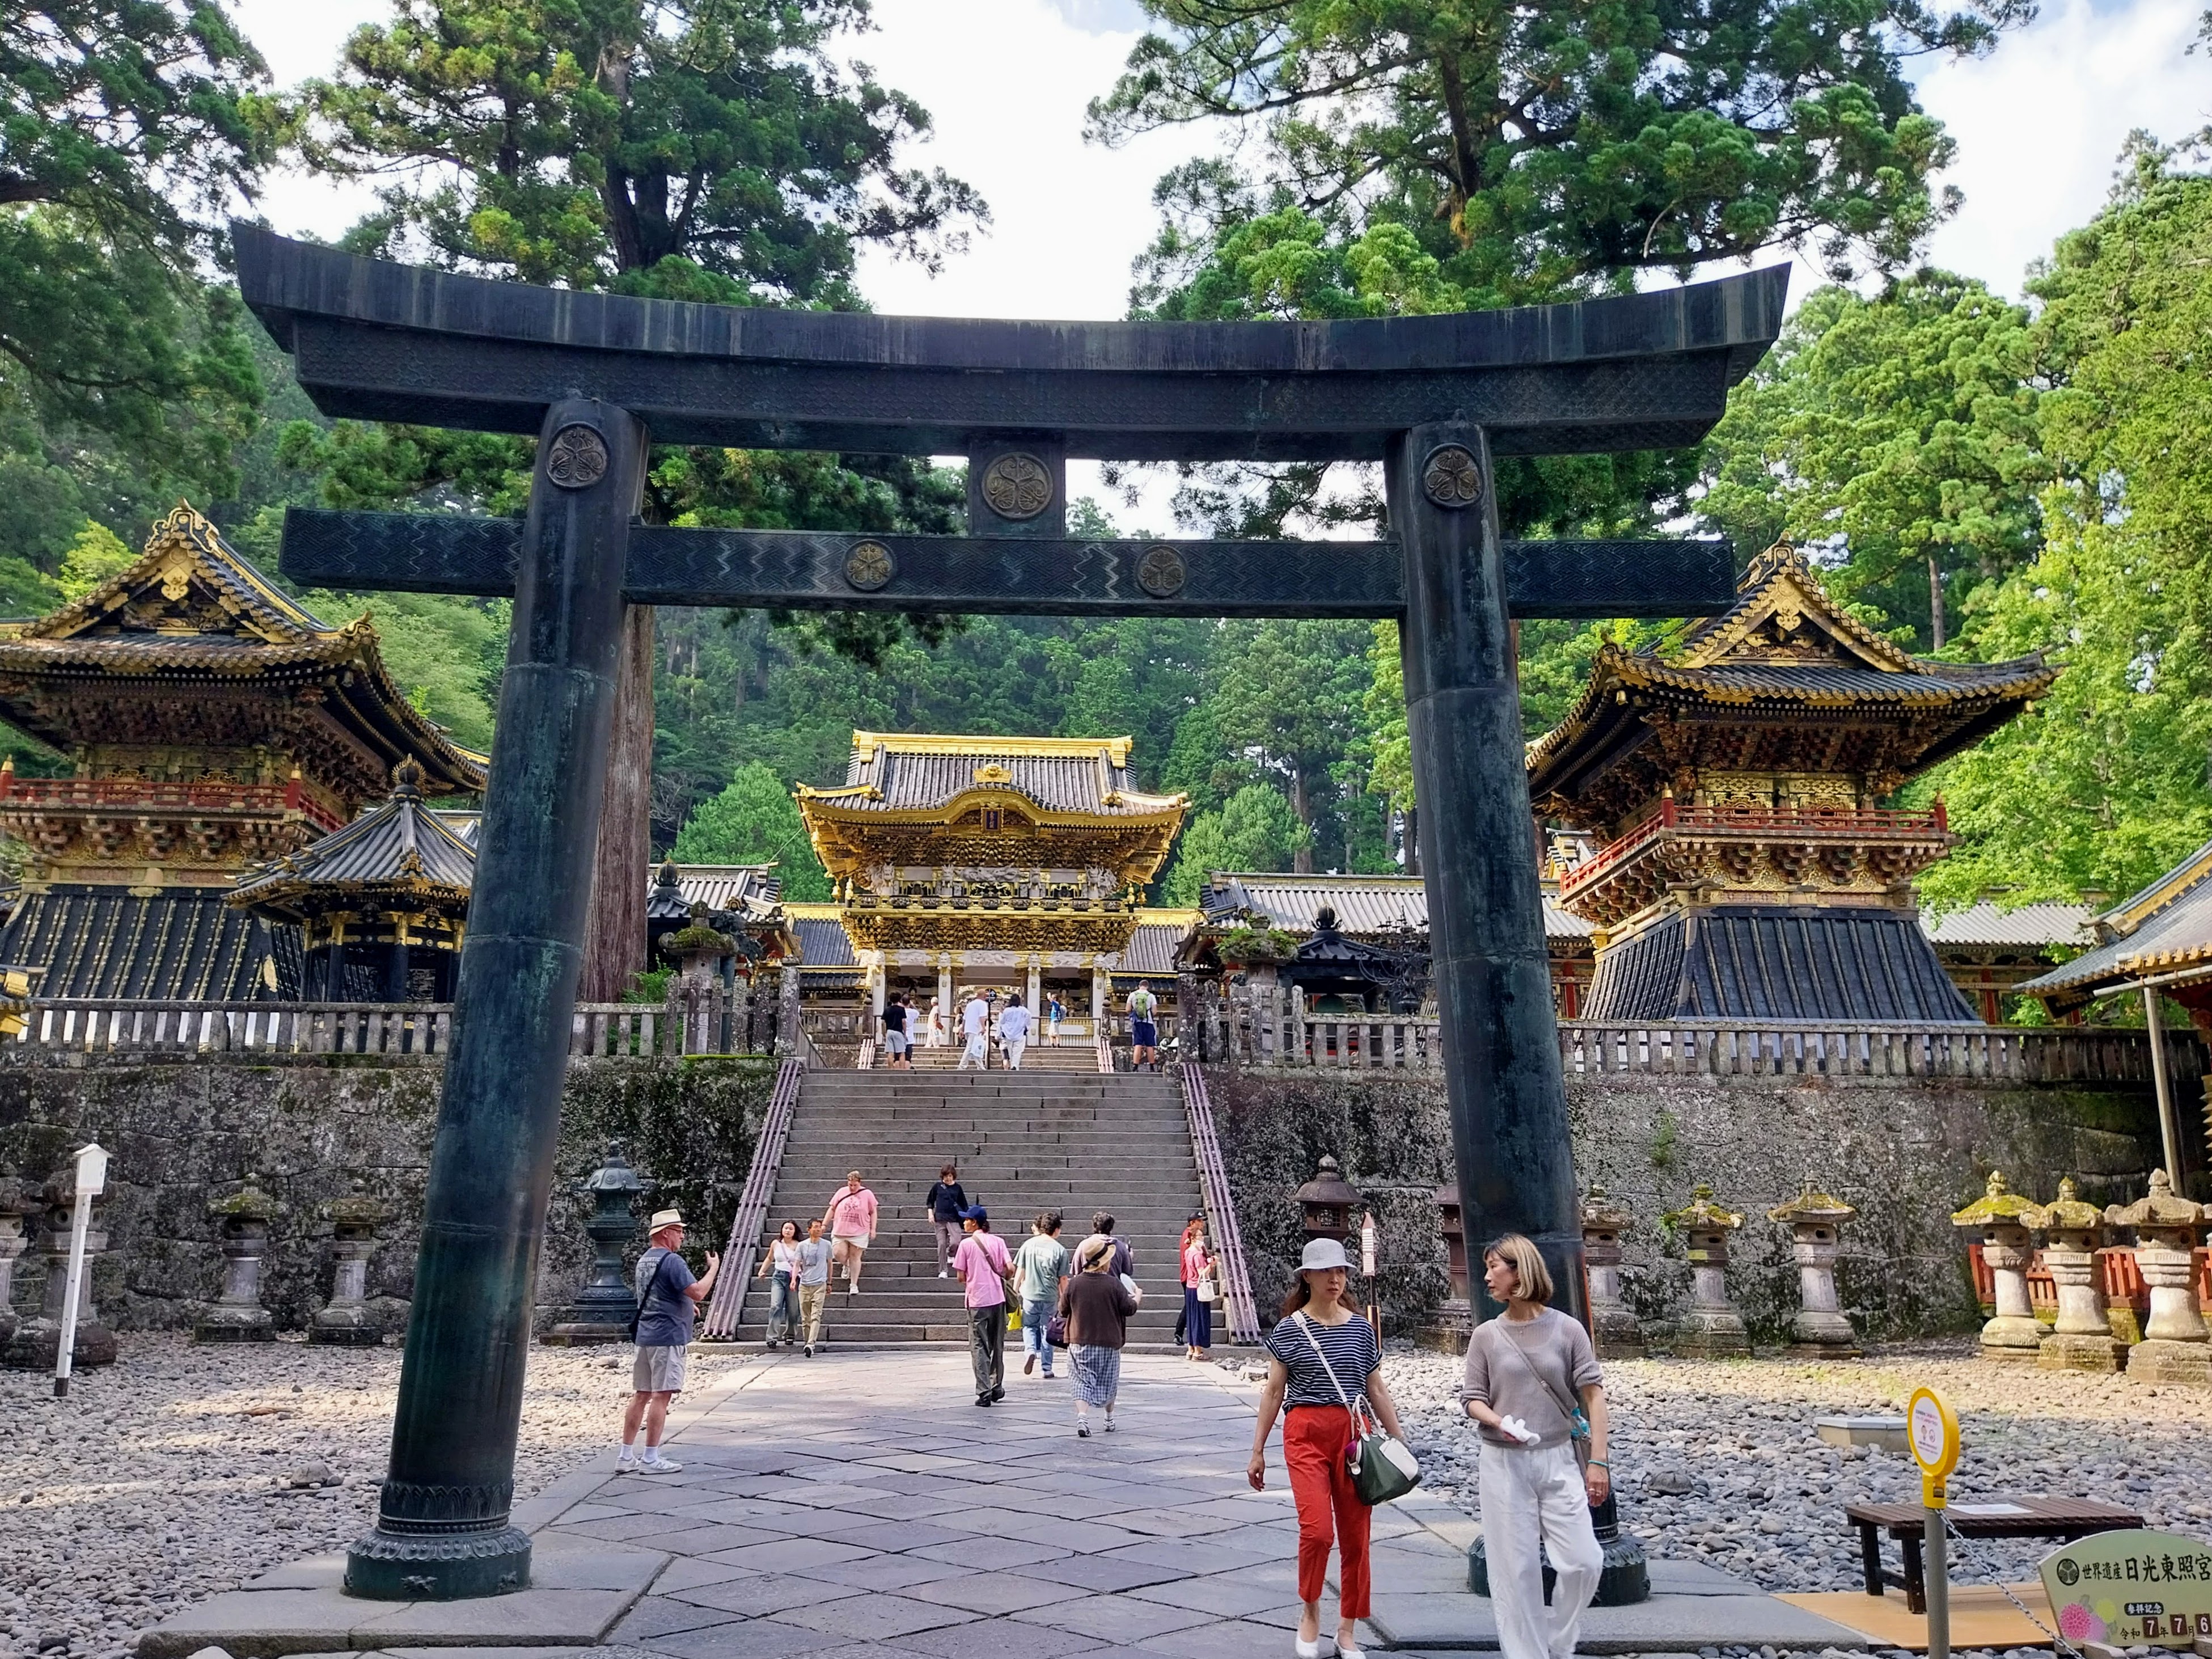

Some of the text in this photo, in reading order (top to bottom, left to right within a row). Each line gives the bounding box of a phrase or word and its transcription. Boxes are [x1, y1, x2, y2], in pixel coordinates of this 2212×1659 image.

[2082, 1553, 2212, 1582] 世界遺産 日光東照宮
[2128, 1603, 2162, 1614] 参拝記念
